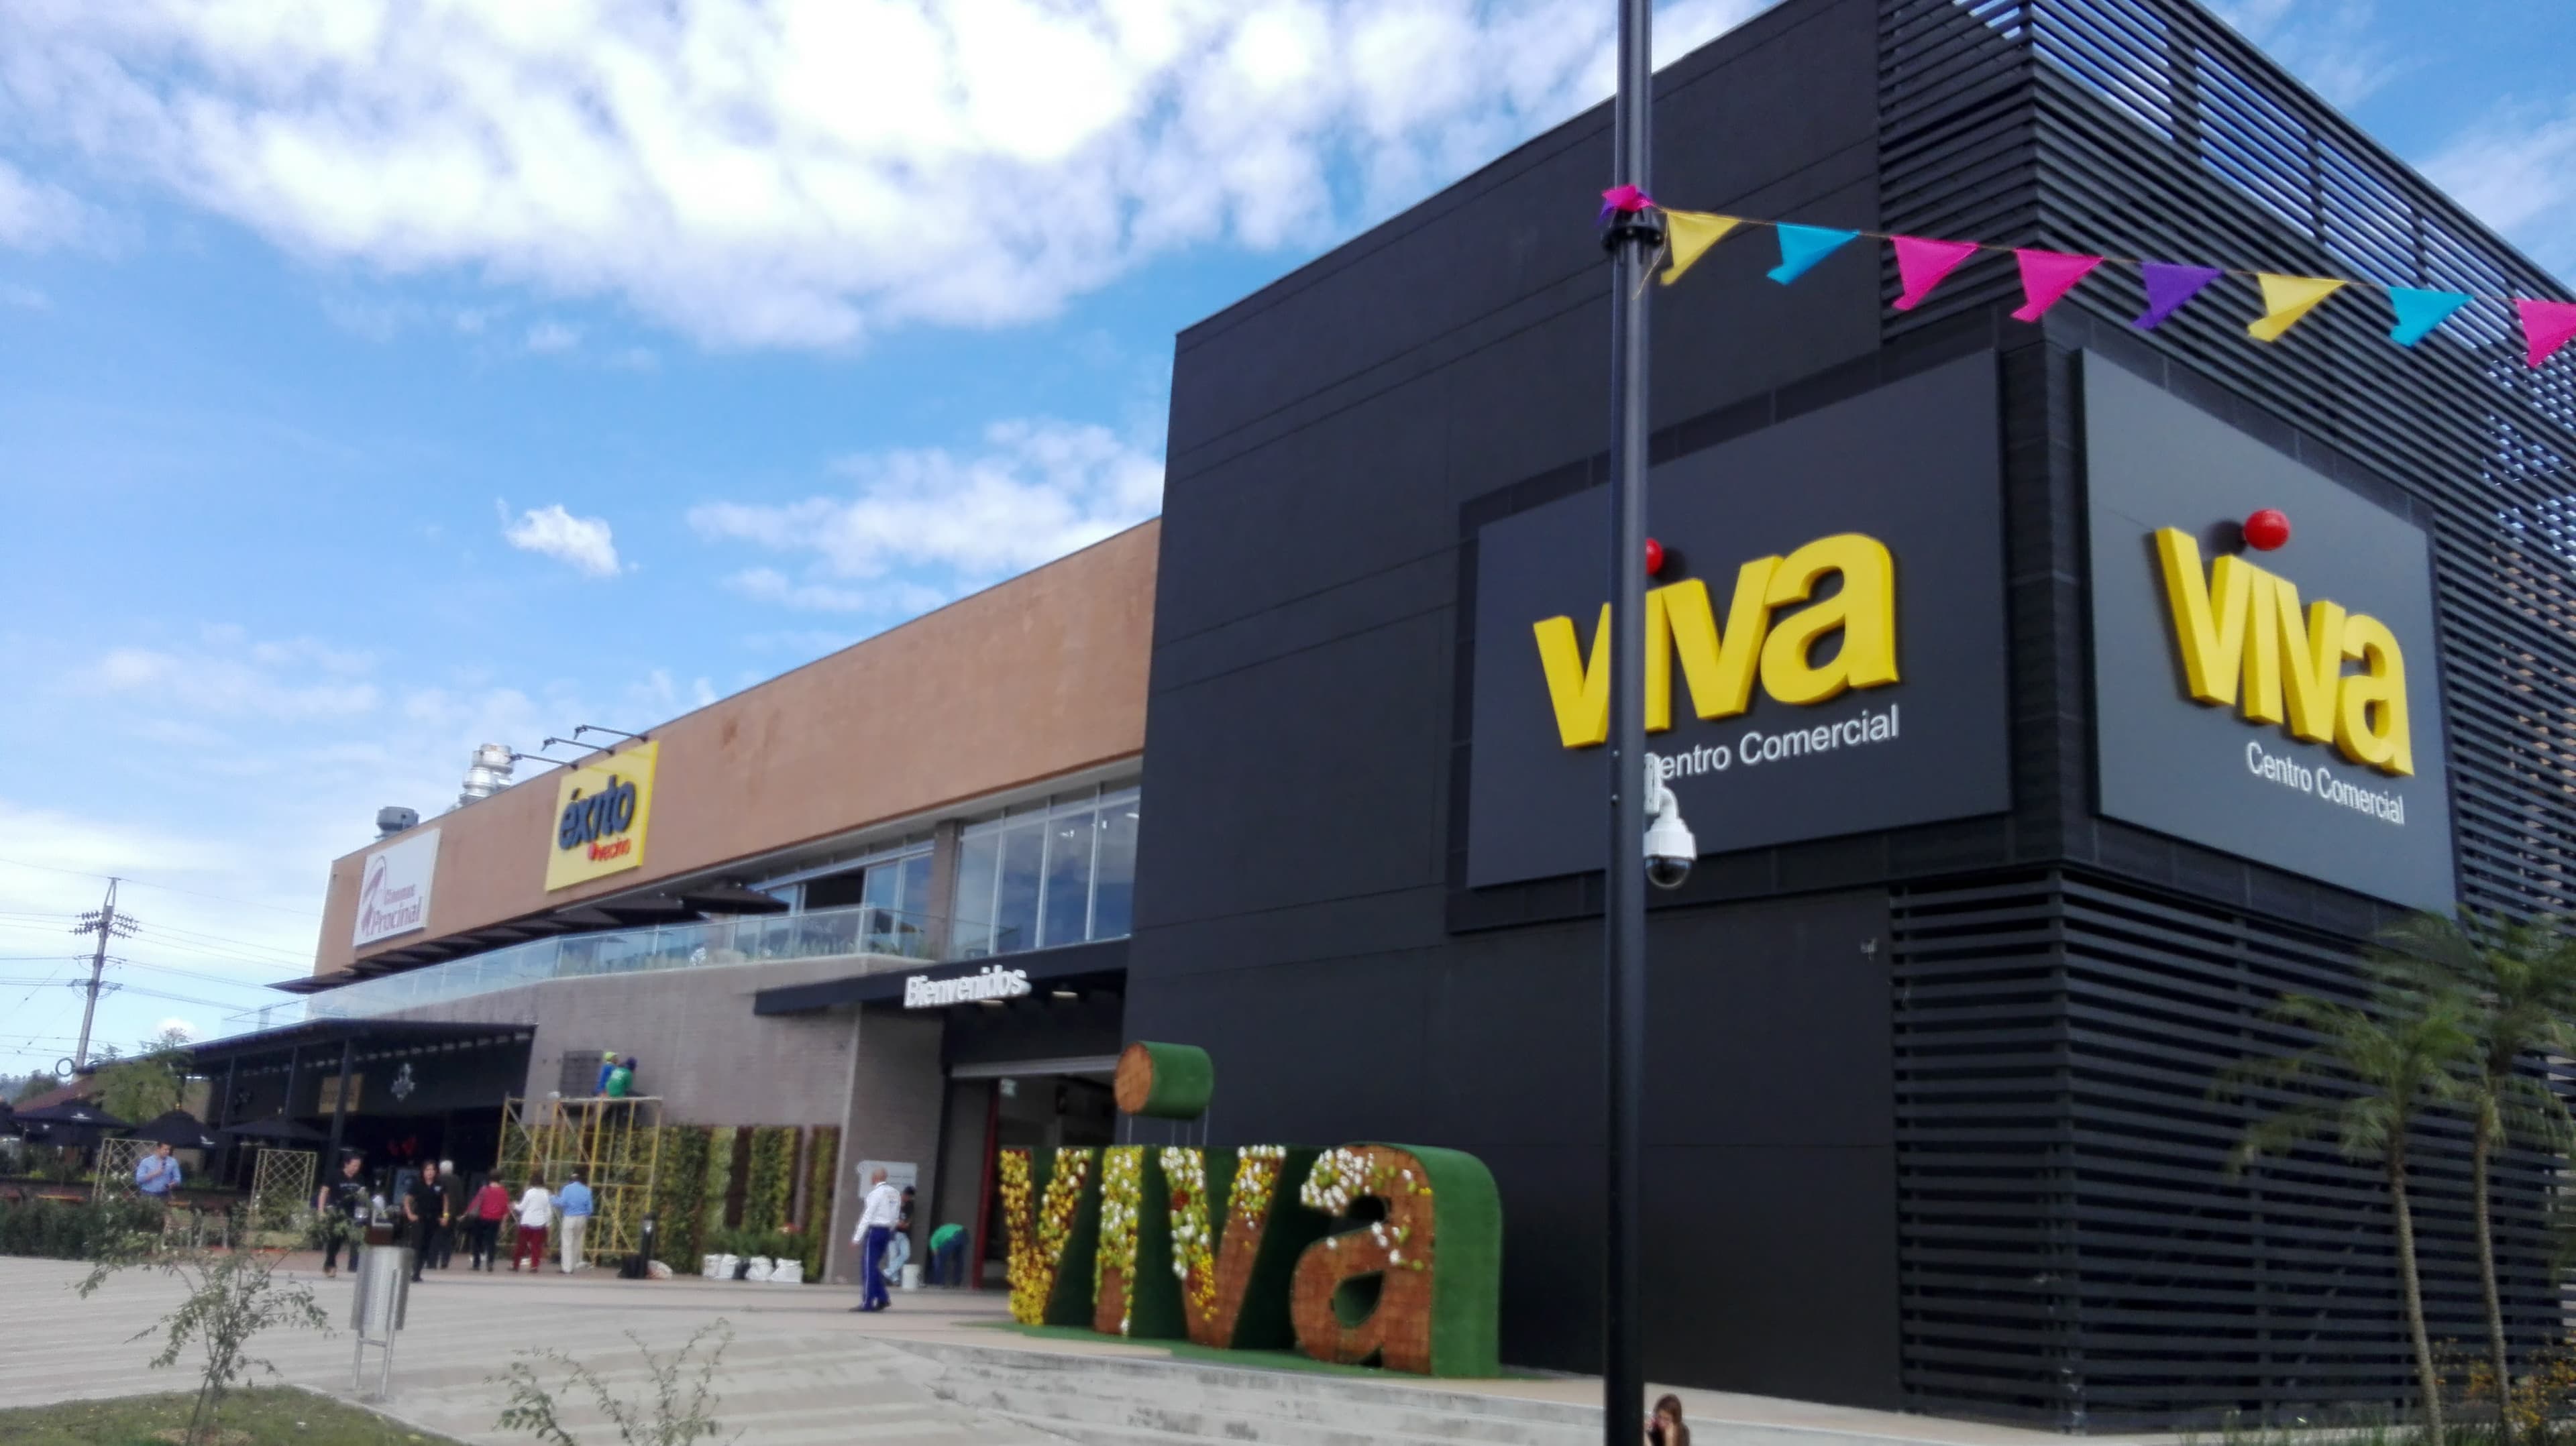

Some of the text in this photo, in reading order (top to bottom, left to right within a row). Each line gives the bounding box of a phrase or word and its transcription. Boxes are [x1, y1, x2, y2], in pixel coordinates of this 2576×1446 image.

[2155, 508, 2415, 777] viva
[1649, 704, 1900, 781] entro Comercial
[558, 774, 636, 850] éxito
[2245, 741, 2405, 826] Centro Comercial
[904, 964, 1030, 1009] Bienvenidos
[1000, 1041, 1502, 1377] viva
